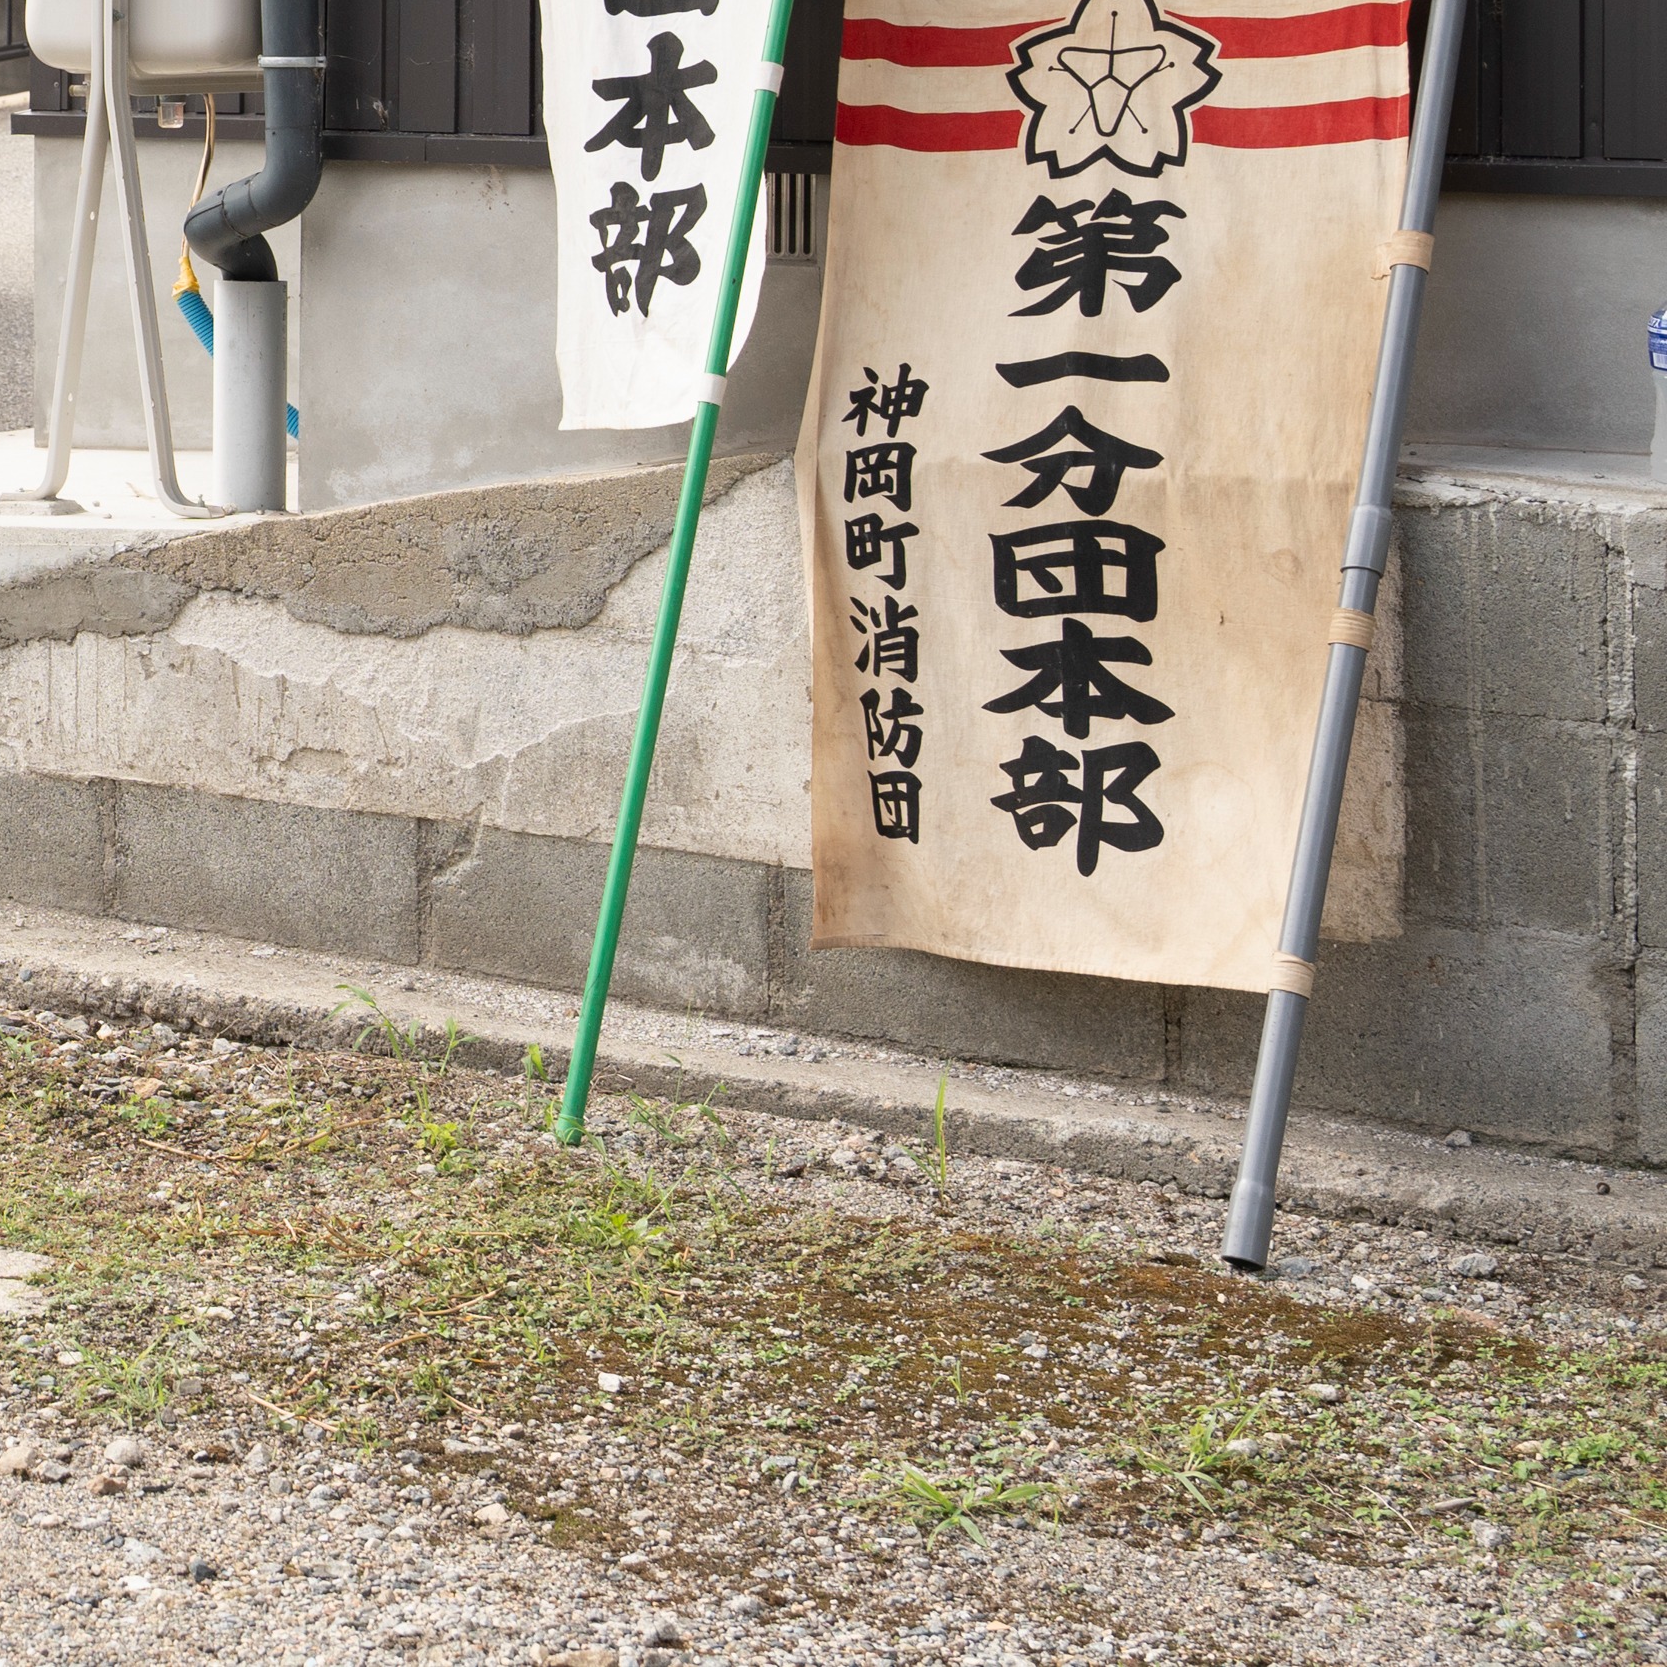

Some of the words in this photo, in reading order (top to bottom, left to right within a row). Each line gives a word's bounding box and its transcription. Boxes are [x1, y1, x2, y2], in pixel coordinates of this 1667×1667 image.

[841, 362, 930, 845] 神岡町消防団
[980, 187, 1187, 877] 第一分団本部
